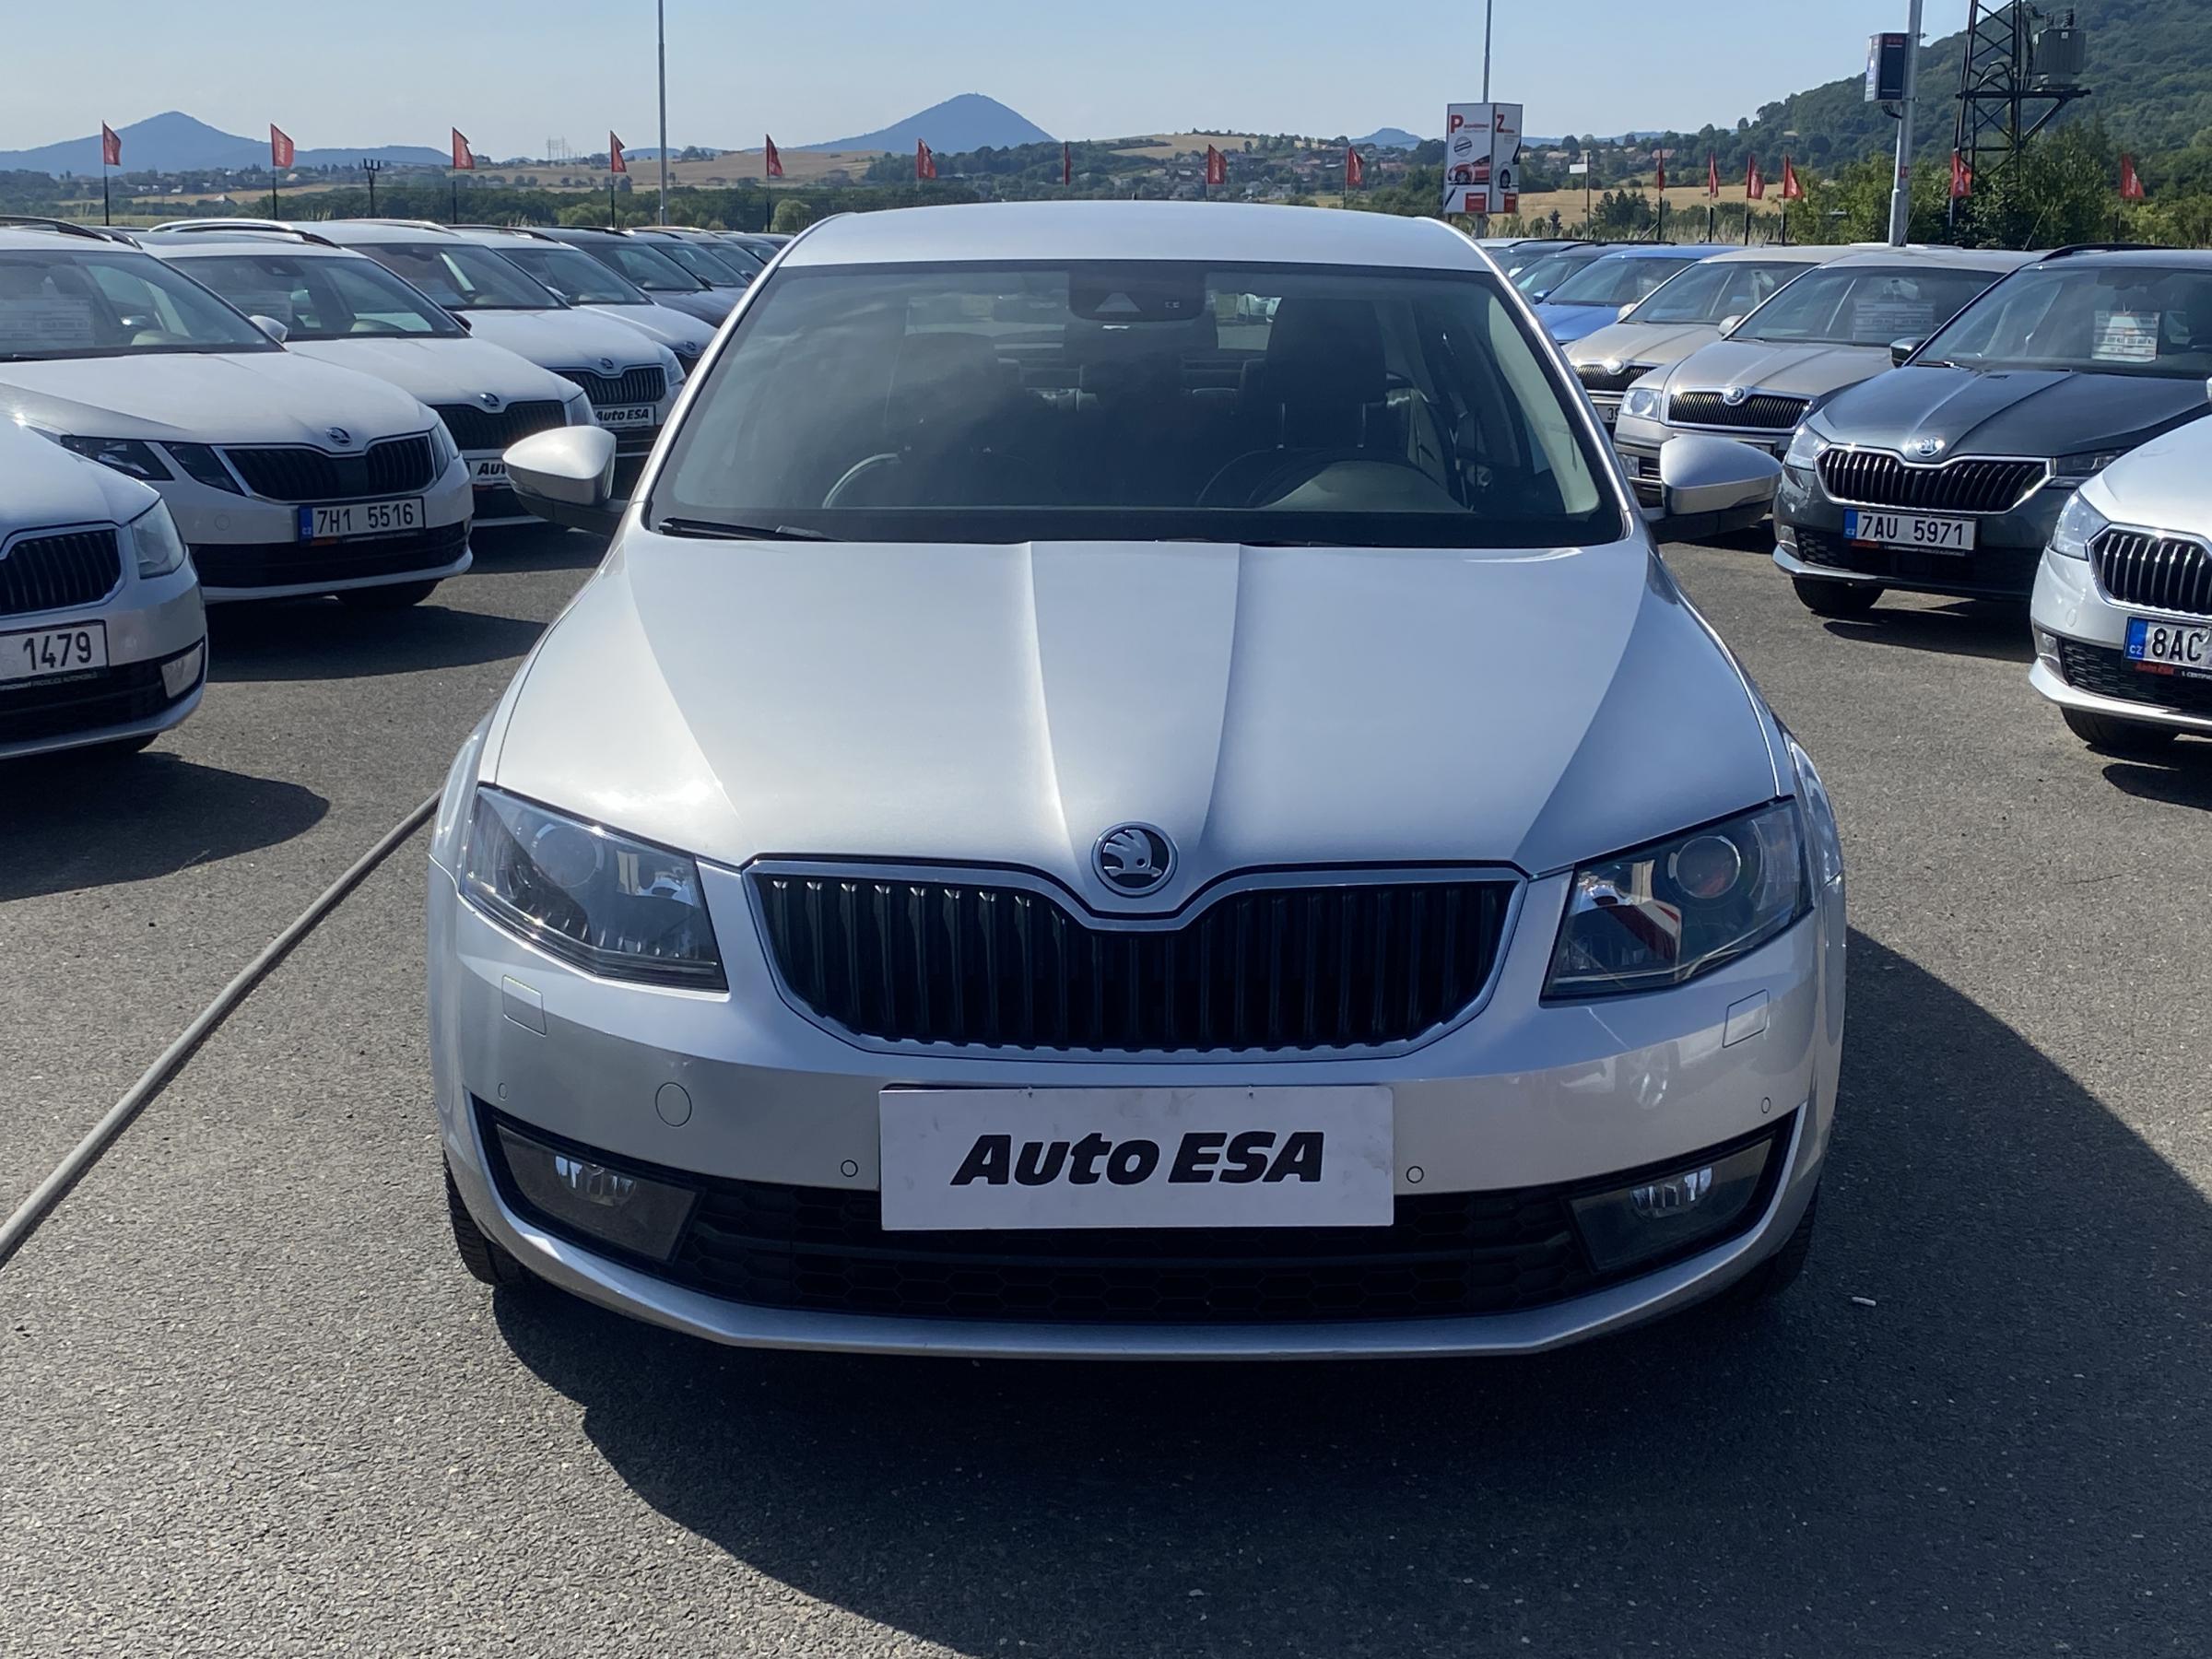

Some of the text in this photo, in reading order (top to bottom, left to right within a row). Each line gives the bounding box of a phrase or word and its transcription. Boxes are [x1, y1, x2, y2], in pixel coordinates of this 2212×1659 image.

[595, 407, 649, 421] Auto ESA
[317, 508, 351, 535] 7H1
[368, 502, 414, 529] 5516
[1862, 514, 1899, 539] 7AU
[1913, 519, 1964, 546] 5971
[23, 631, 92, 671] 1479
[2129, 627, 2204, 662] CZ 8AC
[949, 1131, 1325, 1186] Auto ESA
